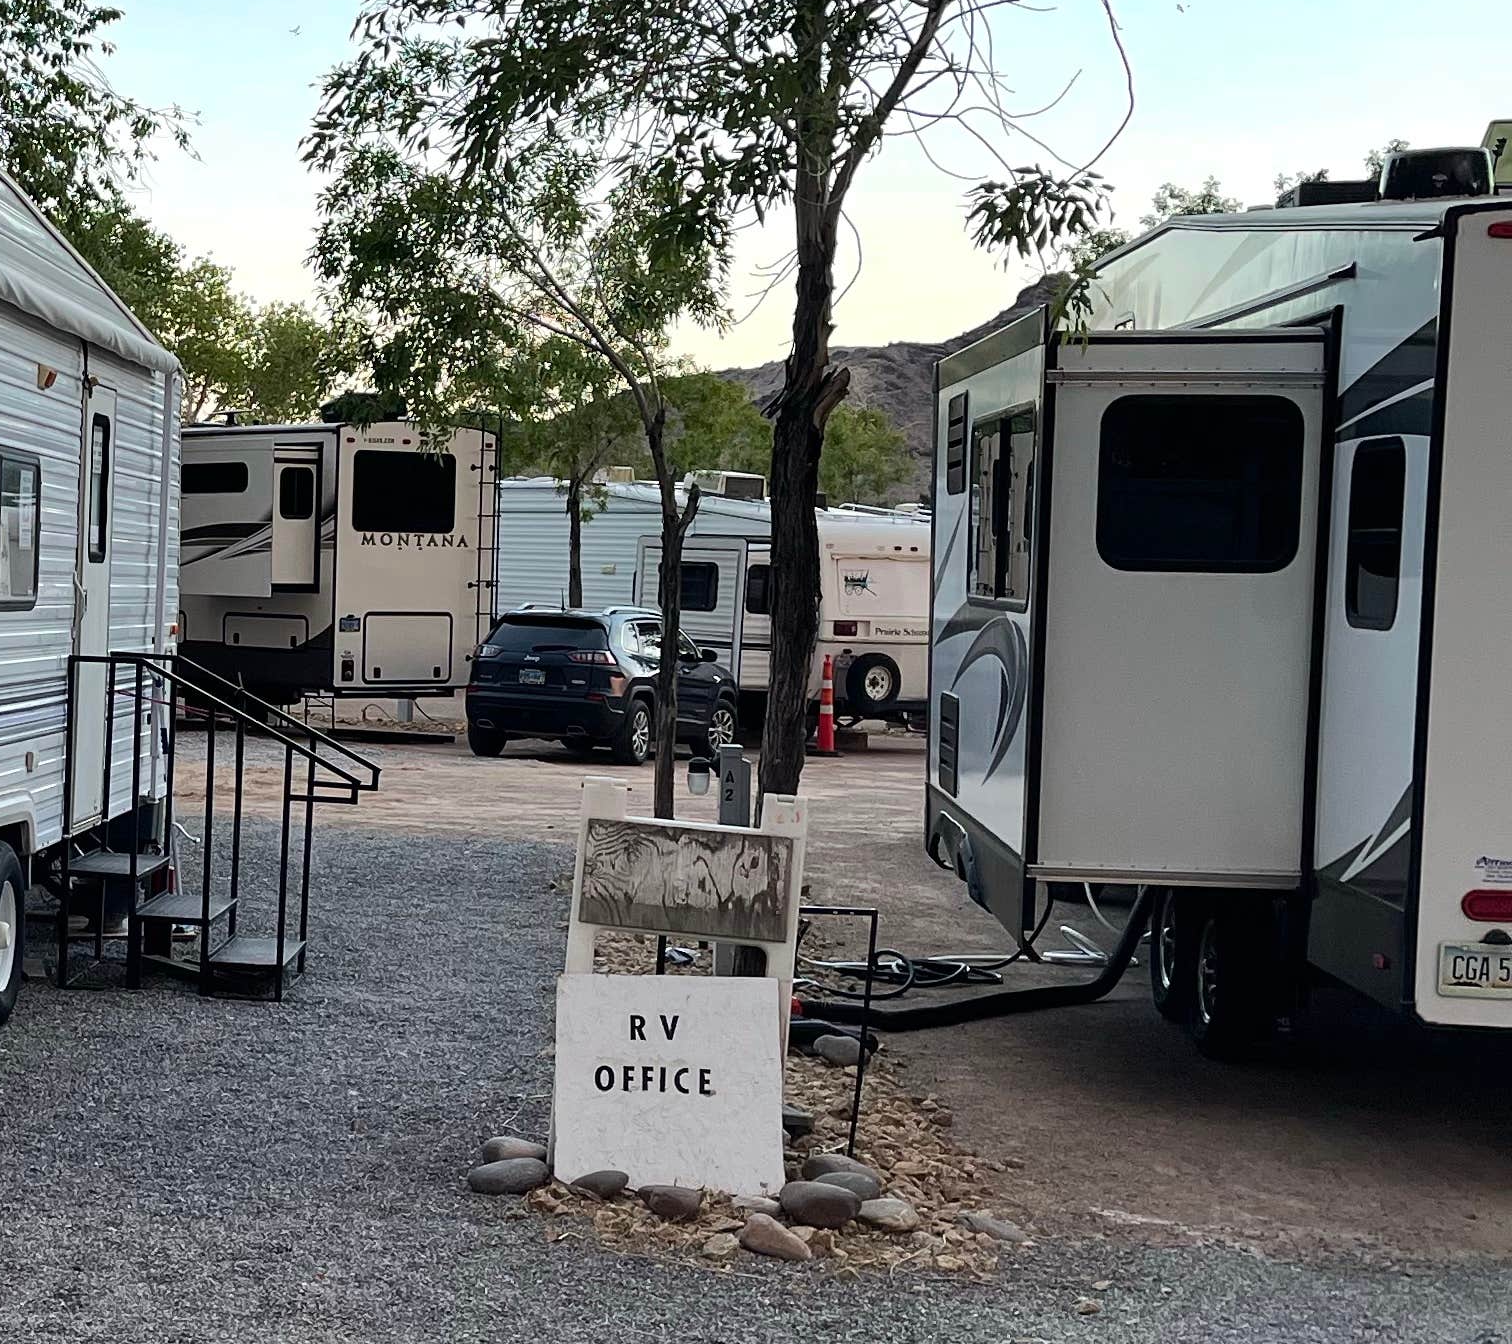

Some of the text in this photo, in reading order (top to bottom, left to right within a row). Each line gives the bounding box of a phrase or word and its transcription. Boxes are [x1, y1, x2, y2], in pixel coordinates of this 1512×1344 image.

[361, 532, 469, 549] MONTANA
[1452, 954, 1490, 982] CGA
[629, 1014, 680, 1041] RV
[594, 1065, 712, 1095] OFFICE
